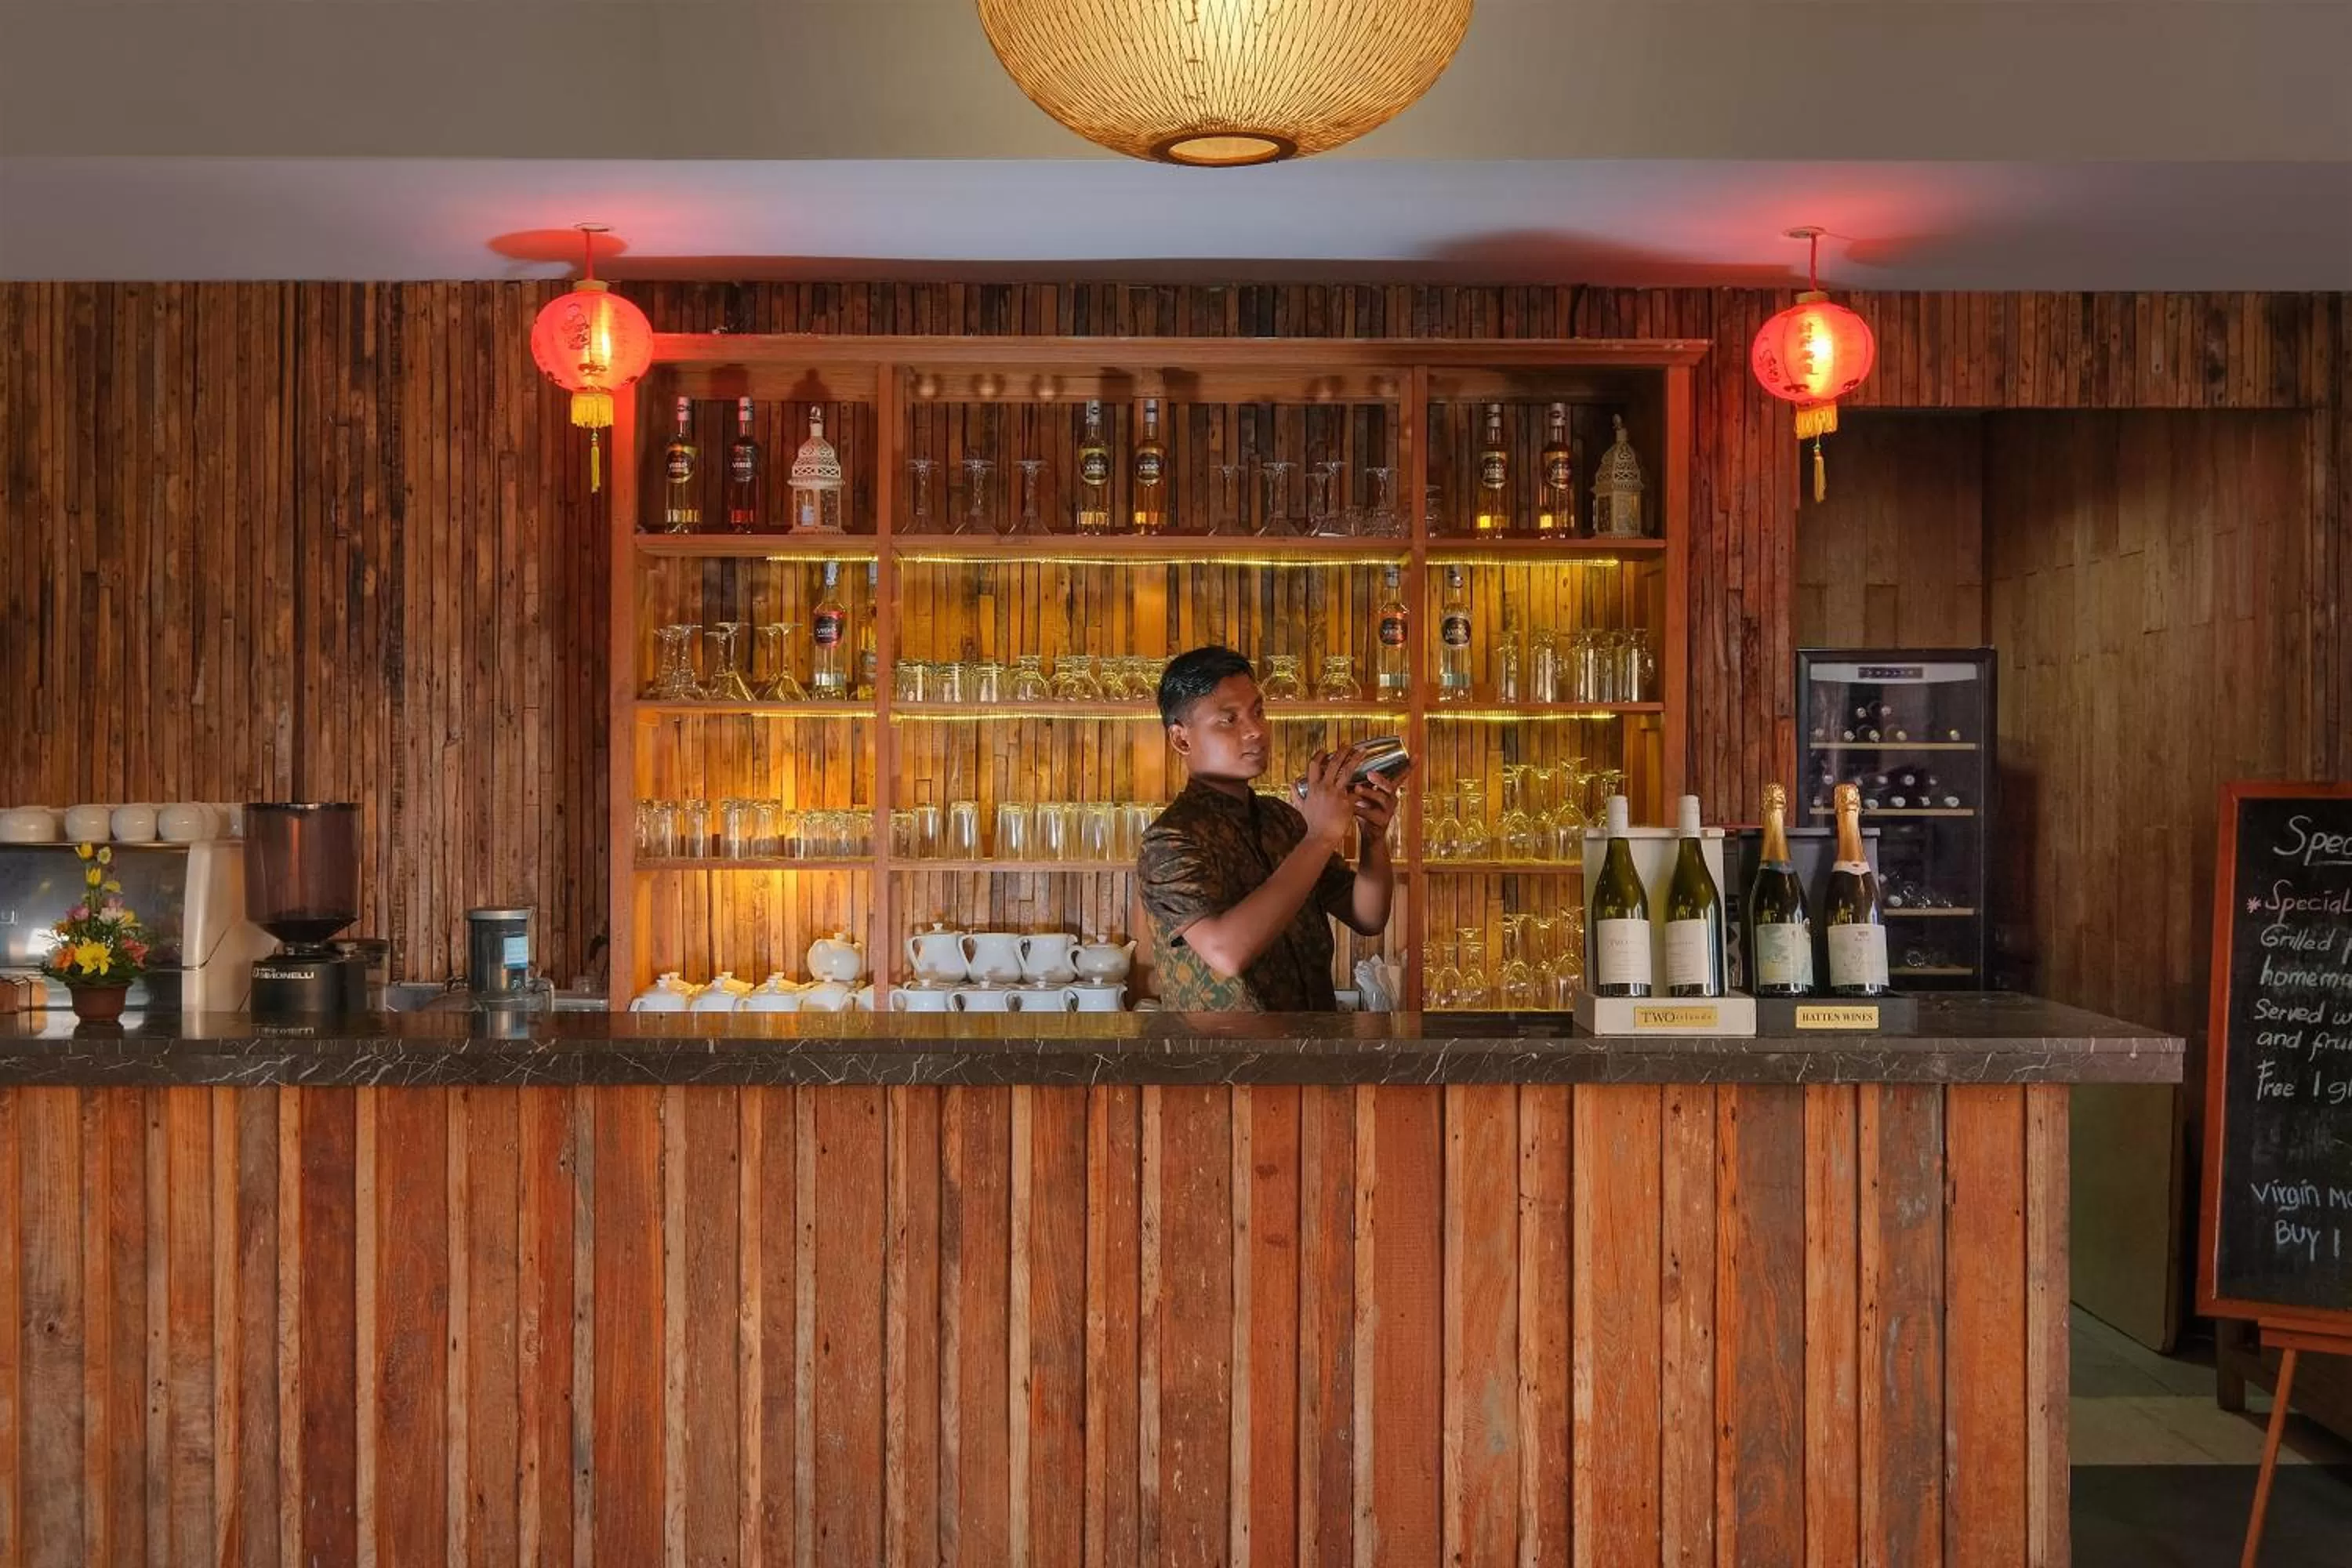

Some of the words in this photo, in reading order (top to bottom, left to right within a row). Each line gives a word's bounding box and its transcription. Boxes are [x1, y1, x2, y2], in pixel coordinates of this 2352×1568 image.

[2260, 924, 2336, 951] Grilled
[1641, 1011, 1675, 1023] TWO
[1802, 1012, 1840, 1022] HATTEN
[1842, 1012, 1873, 1022] WINES
[2254, 998, 2325, 1024] Served
[2256, 1029, 2303, 1049] and
[2257, 1059, 2296, 1101] Free
[2250, 1178, 2321, 1213] Virgin
